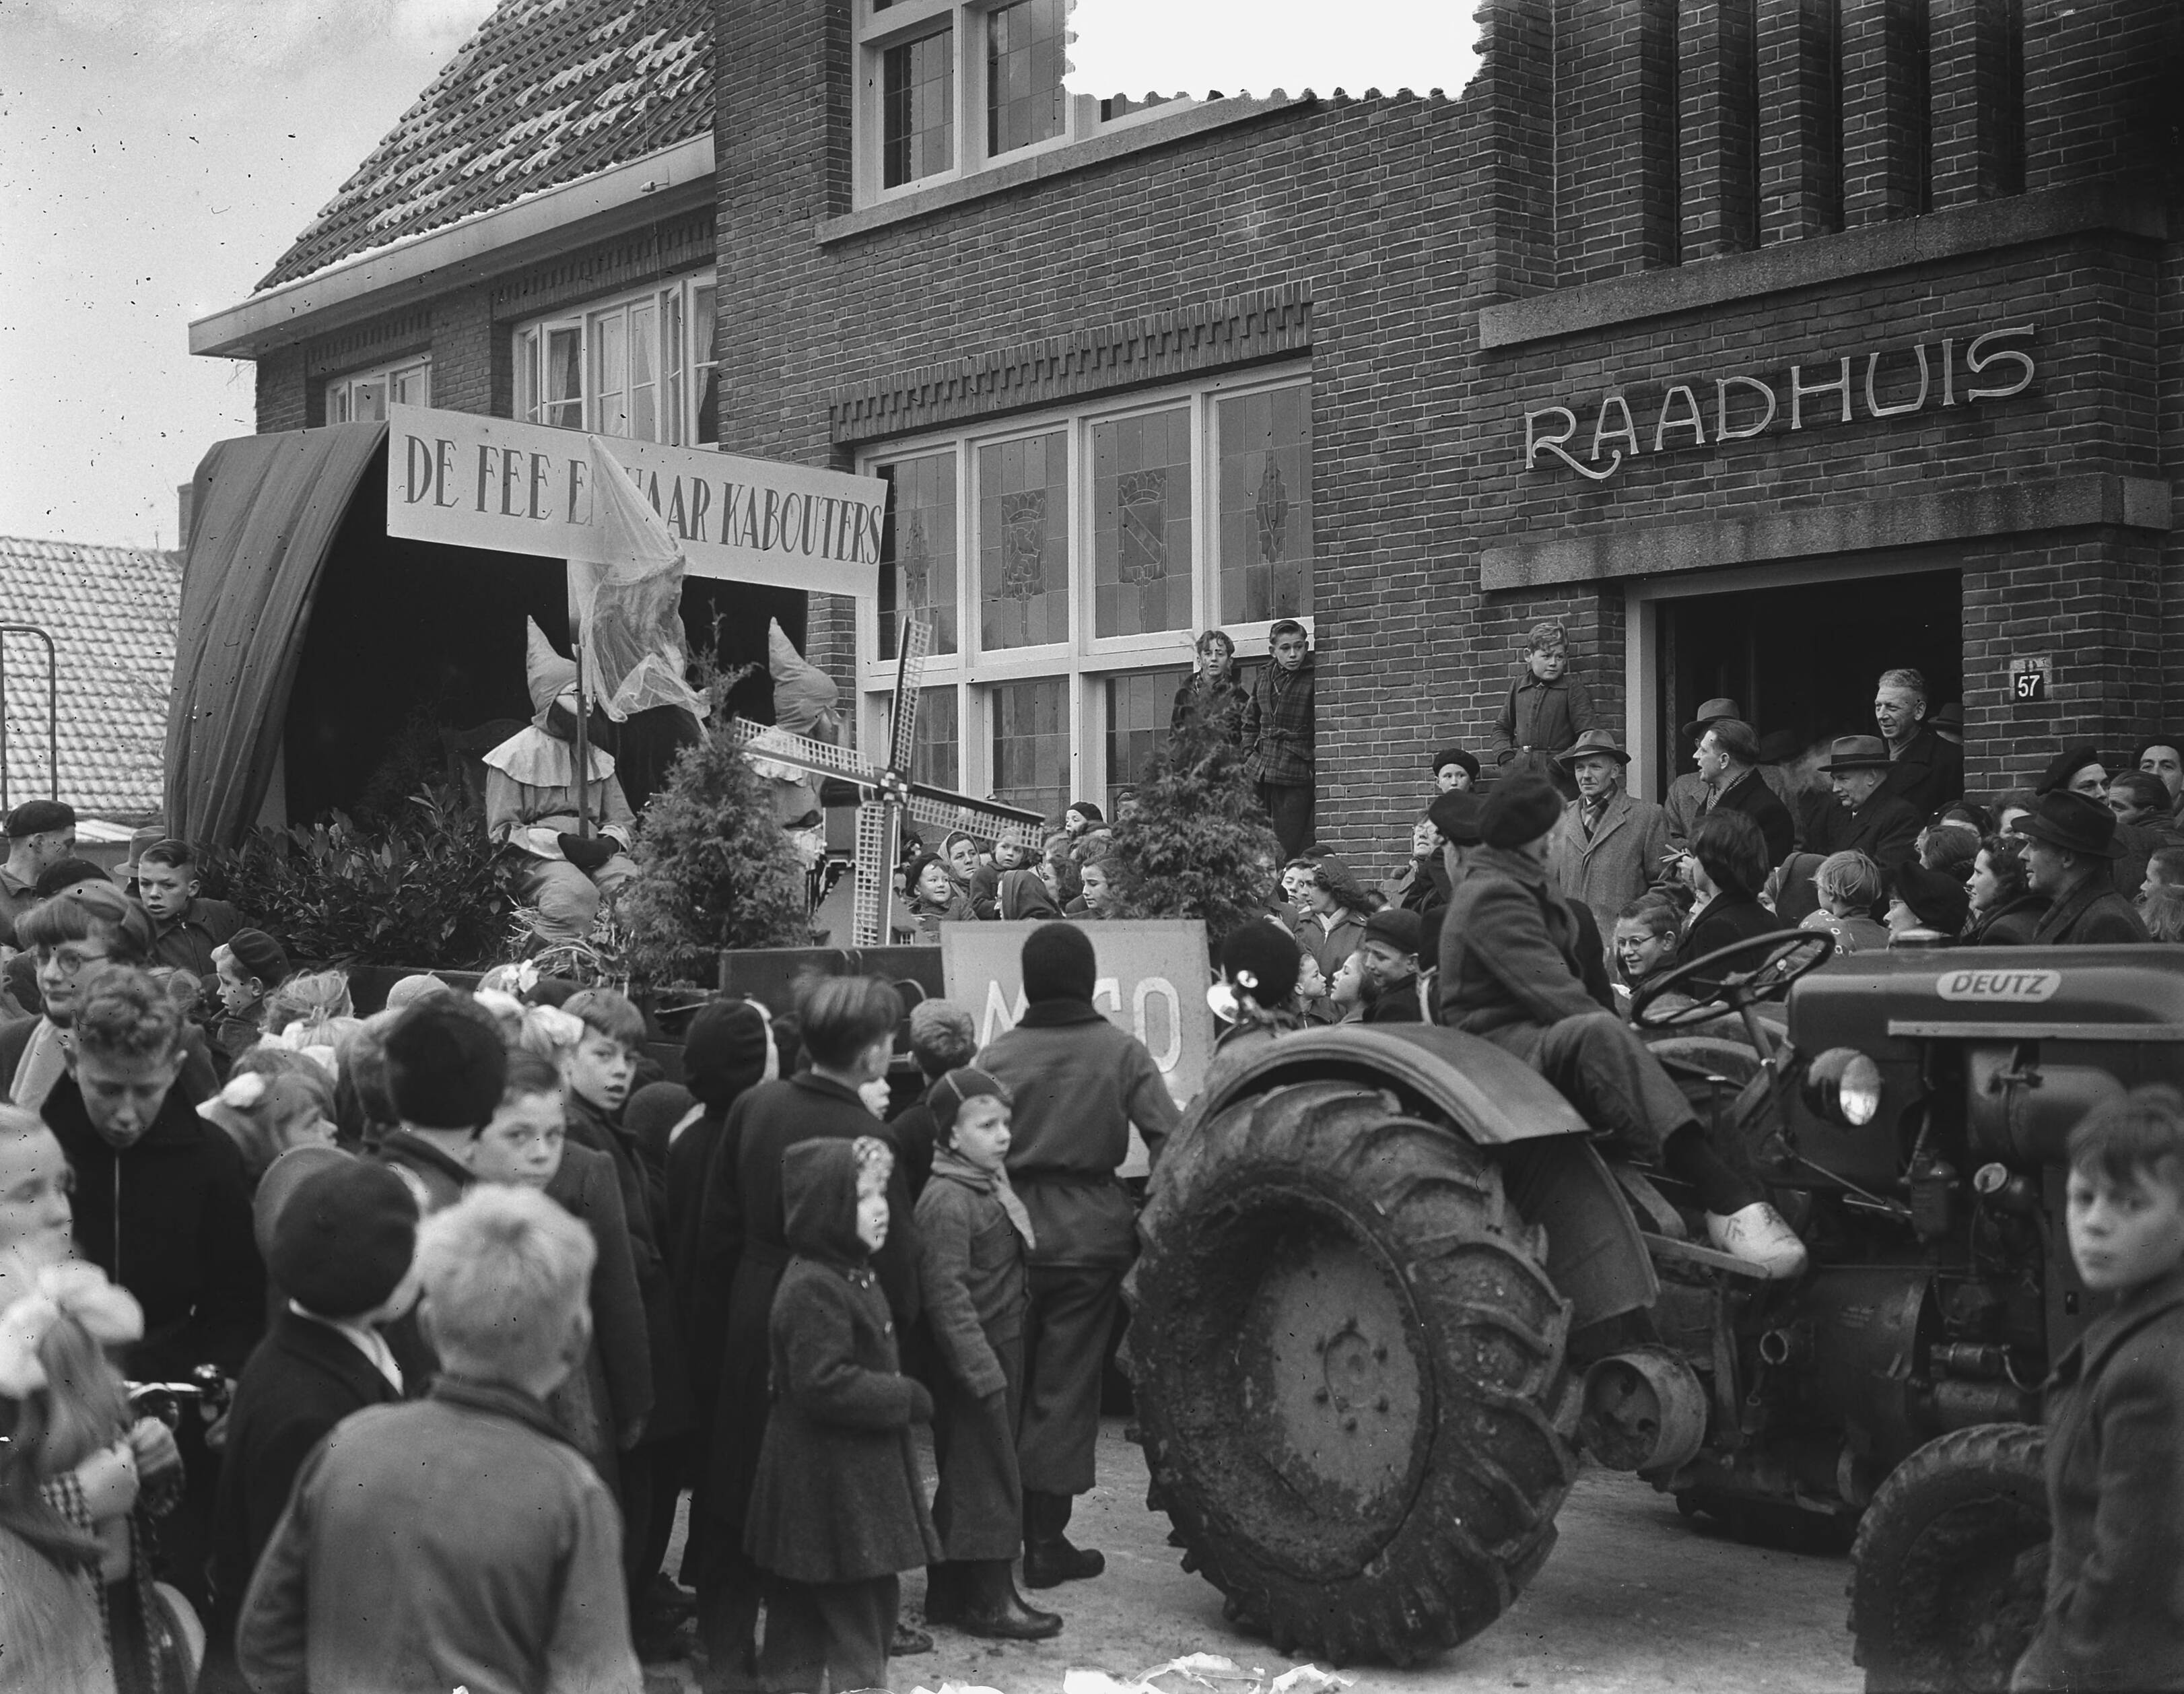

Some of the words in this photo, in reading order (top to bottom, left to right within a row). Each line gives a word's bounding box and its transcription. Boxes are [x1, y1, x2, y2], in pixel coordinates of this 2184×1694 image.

[1524, 323, 2035, 479] RAADHUIS
[404, 434, 459, 508] DE
[475, 444, 553, 520] FEE
[719, 482, 882, 565] KABOUTERS
[2018, 675, 2041, 698] 57
[1951, 975, 2049, 994] DEUTZ
